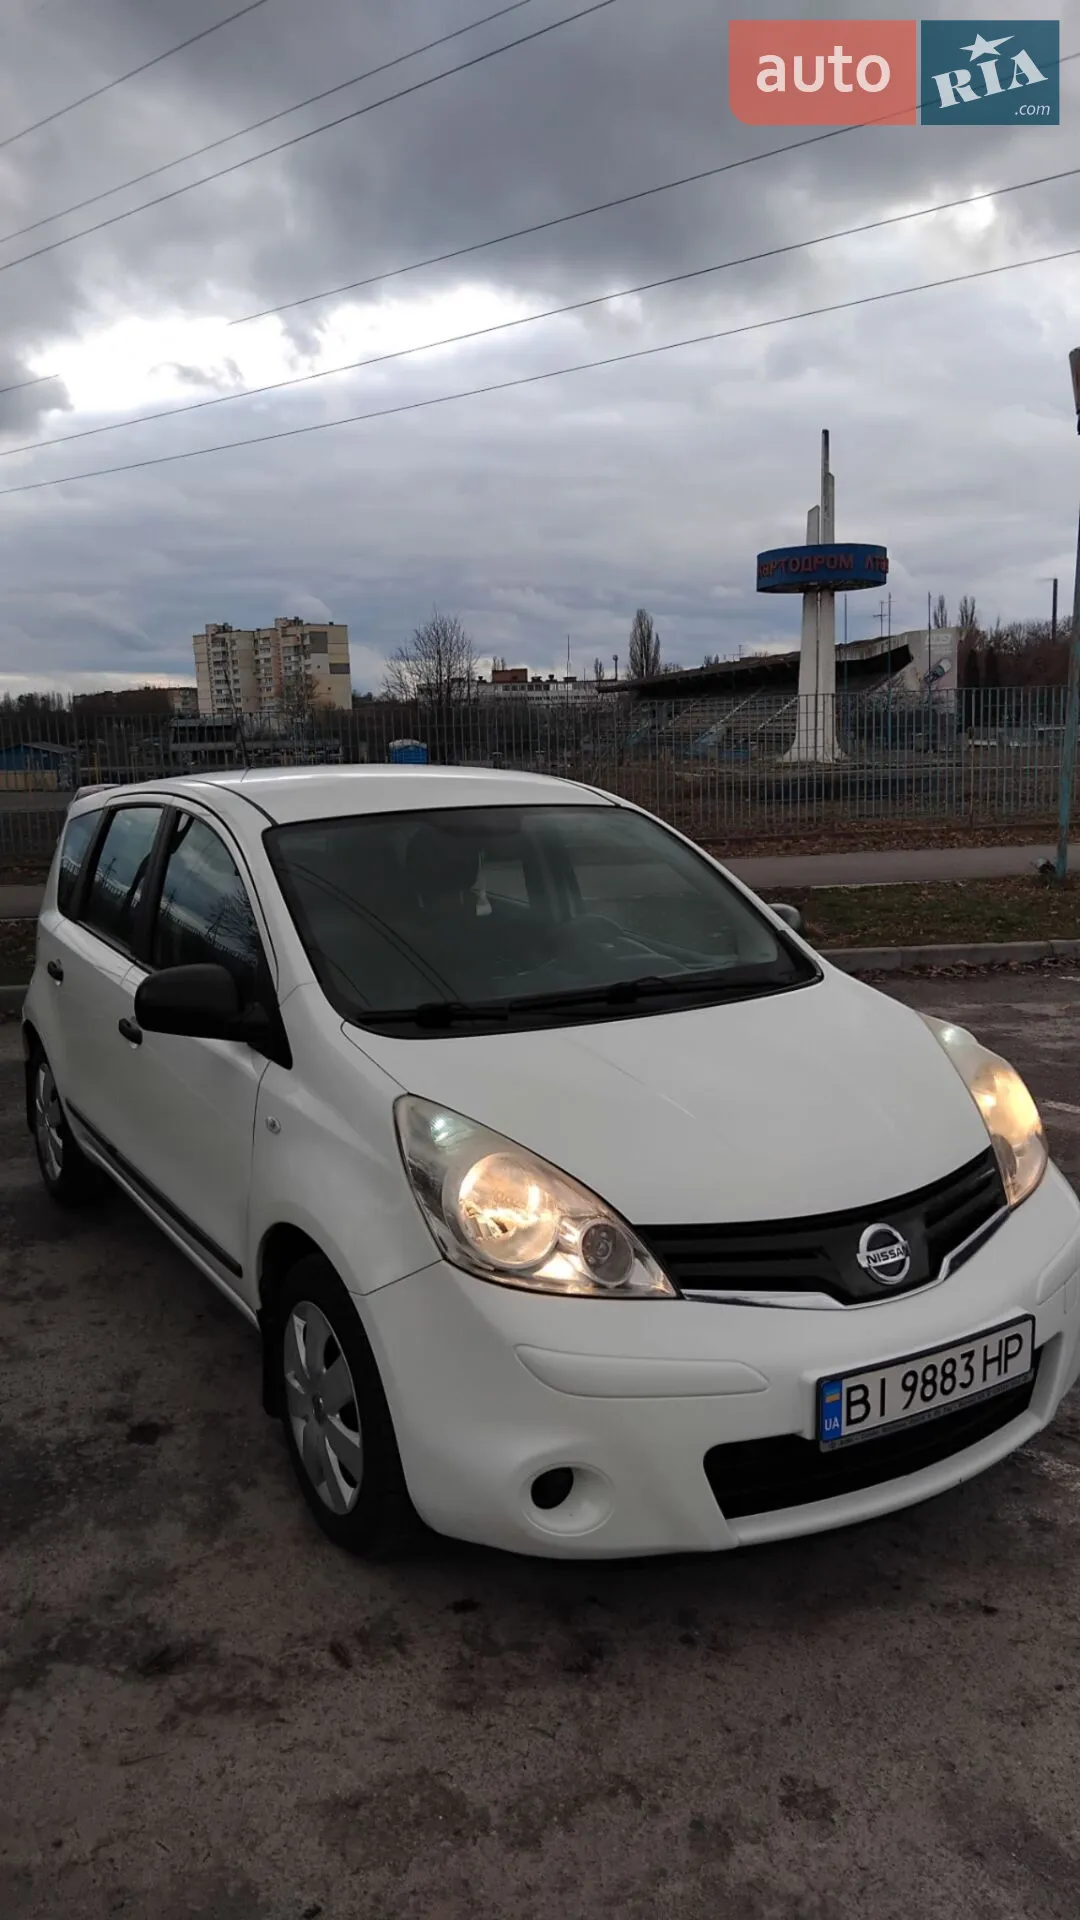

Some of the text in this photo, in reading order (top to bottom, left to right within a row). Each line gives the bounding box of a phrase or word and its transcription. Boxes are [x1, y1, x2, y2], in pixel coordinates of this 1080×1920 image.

[846, 1378, 886, 1426] BI
[901, 1349, 975, 1411] 9883
[982, 1333, 1023, 1382] HP
[824, 1417, 840, 1431] UA
